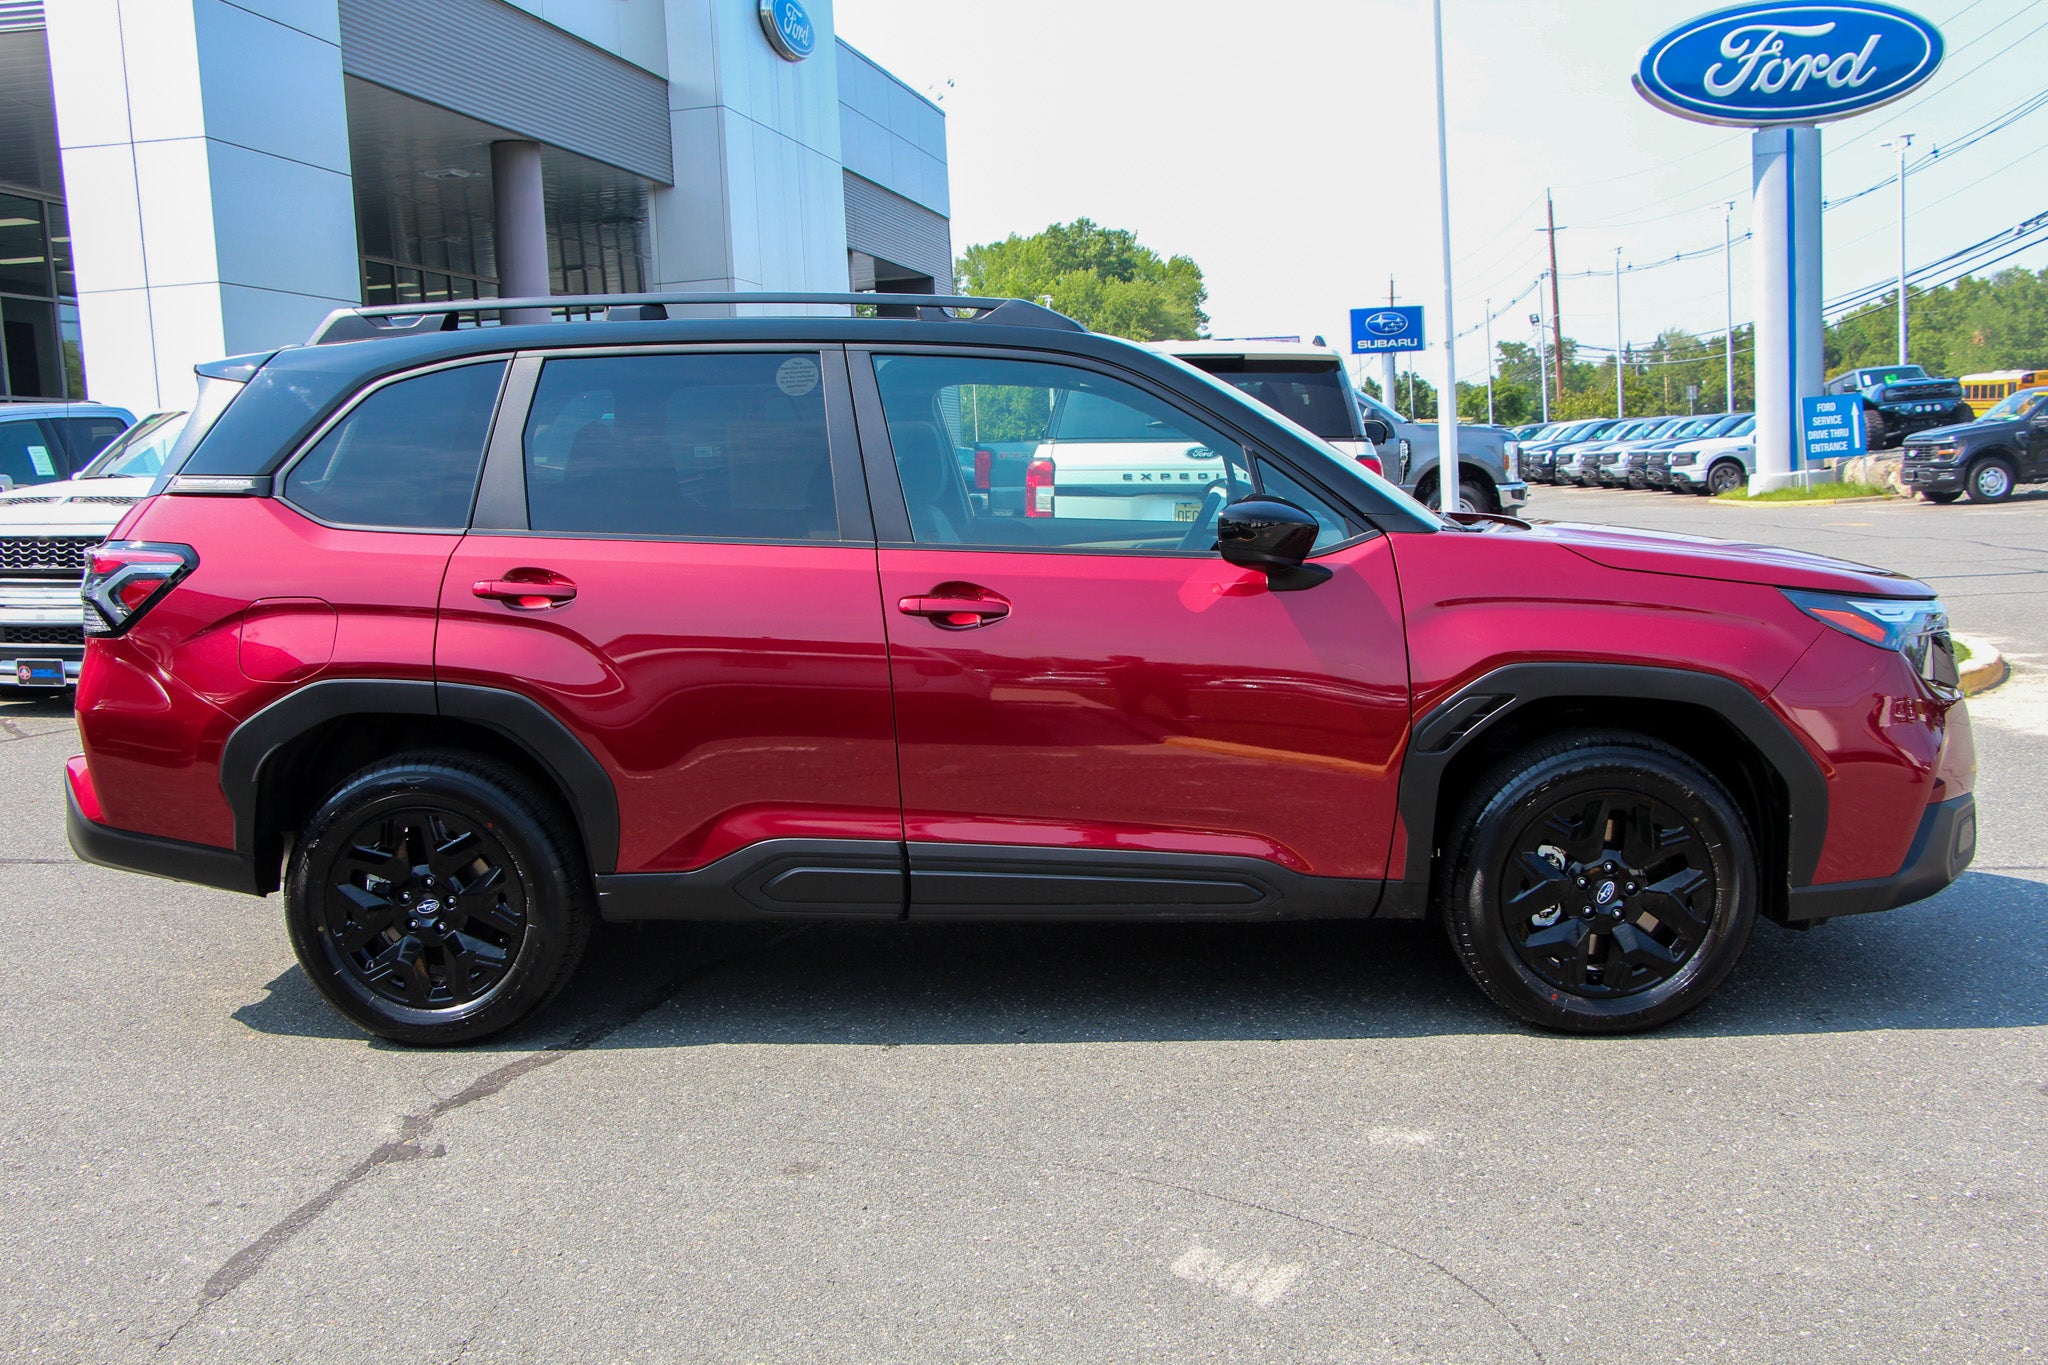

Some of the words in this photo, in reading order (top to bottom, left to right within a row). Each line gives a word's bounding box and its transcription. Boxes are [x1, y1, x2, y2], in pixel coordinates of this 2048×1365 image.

[784, 3, 809, 47] Ford
[1703, 21, 1882, 97] Ford
[1357, 338, 1418, 349] SUBARU
[1816, 402, 1836, 412] FORD
[1812, 415, 1842, 426] SERVICE
[1808, 429, 1829, 440] DRIVE
[1830, 428, 1849, 438] THRU
[1810, 441, 1848, 453] ENTRANCE
[1192, 448, 1214, 458] Ford
